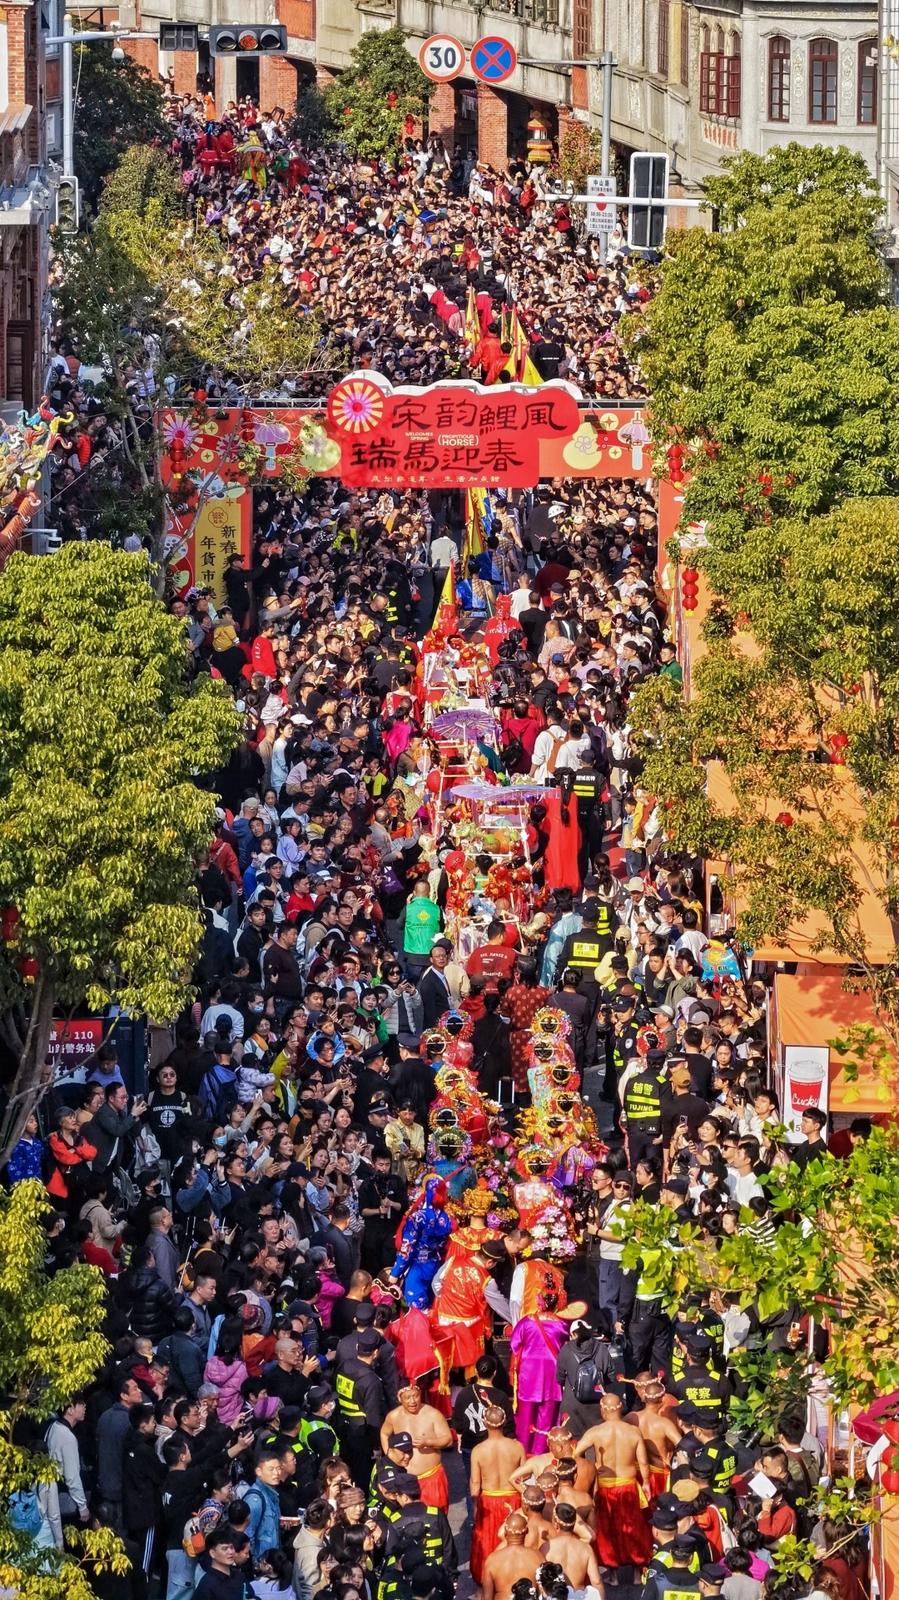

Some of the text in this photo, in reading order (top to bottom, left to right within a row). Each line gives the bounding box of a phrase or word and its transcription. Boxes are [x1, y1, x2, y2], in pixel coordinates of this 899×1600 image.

[429, 47, 456, 69] 30
[593, 179, 609, 187] 中山路
[351, 437, 525, 474] 瑞馬迎春
[74, 1031, 93, 1040] 110
[630, 1104, 653, 1112] FUJING
[686, 1387, 711, 1400] 警察
